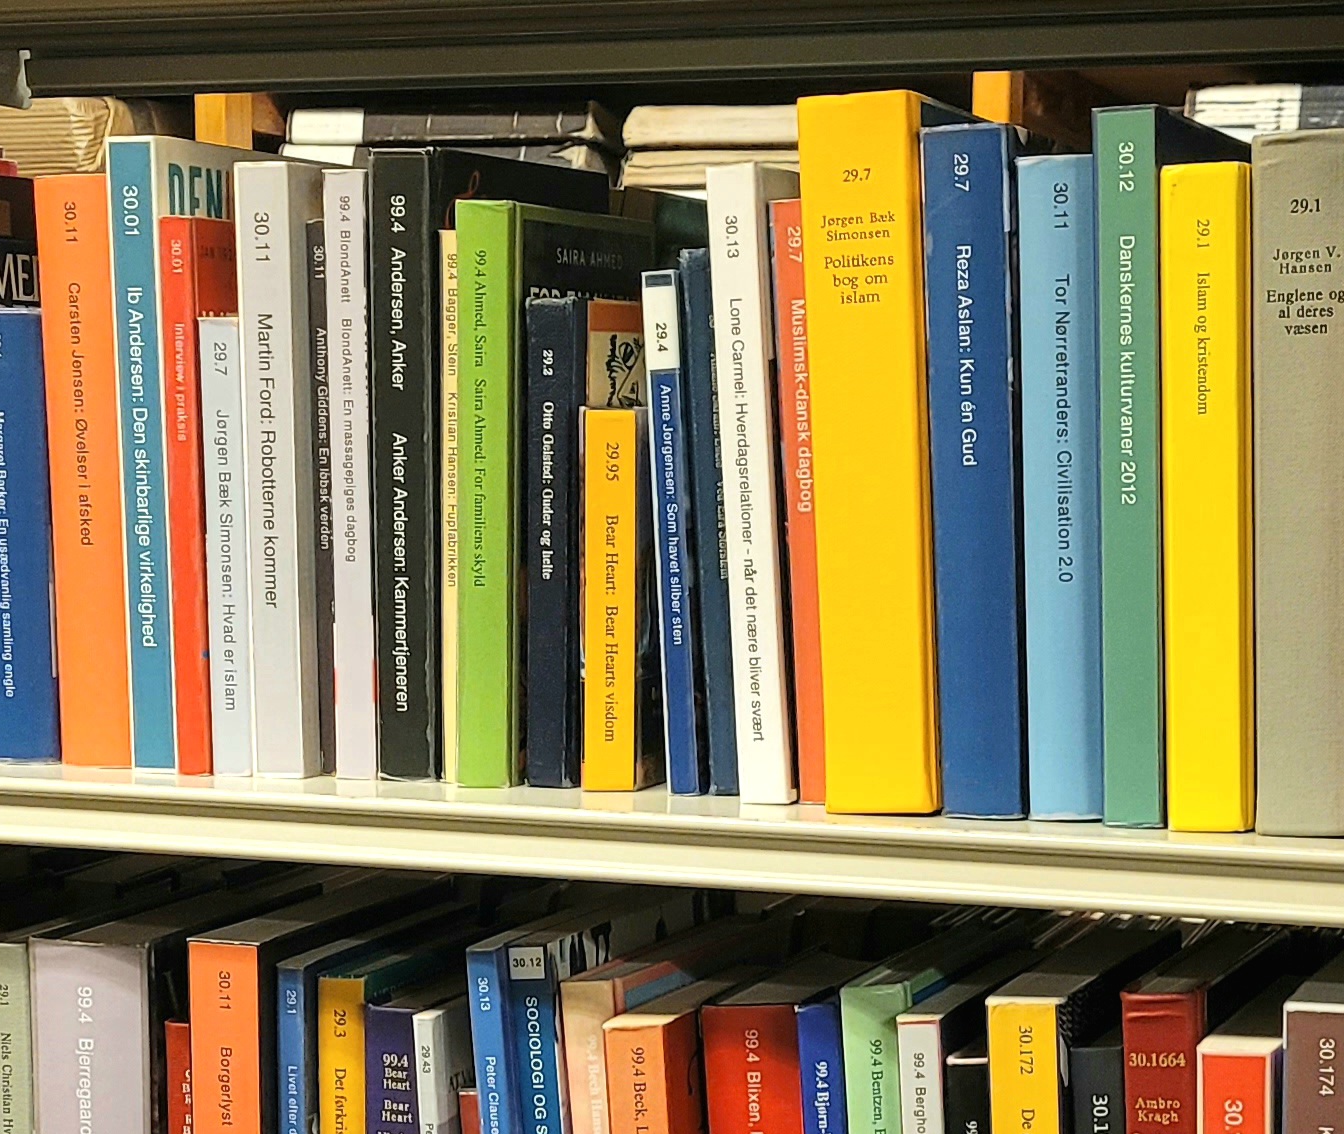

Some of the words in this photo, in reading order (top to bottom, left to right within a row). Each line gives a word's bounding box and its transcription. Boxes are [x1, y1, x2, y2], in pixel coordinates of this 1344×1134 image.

[842, 167, 871, 183] 29.7
[122, 185, 140, 235] 30.01
[389, 194, 406, 233] 99.4
[820, 215, 864, 229] Jørgen
[869, 211, 896, 223] Bæk
[1290, 198, 1321, 214] 29.1
[826, 229, 891, 242] Simonsen
[824, 254, 895, 269] Politikens
[1272, 248, 1320, 263] Jørgen
[1325, 245, 1341, 259] V.
[1279, 263, 1332, 275] Hansen
[126, 286, 143, 304] Ib
[389, 246, 407, 335] Andersen,
[832, 274, 859, 289] bog
[864, 274, 888, 285] om
[840, 290, 881, 304] islam
[1266, 288, 1324, 305] Englene
[1278, 306, 1290, 319] al
[1296, 305, 1334, 318] deres
[1284, 323, 1328, 336] væsen
[127, 308, 145, 402] Andersen:
[391, 339, 407, 391] Anker
[132, 405, 149, 444] Den
[392, 432, 408, 484] Anker
[133, 448, 153, 546] skinbarlige
[392, 486, 409, 572] Andersen:
[137, 550, 158, 647] virkelighed
[391, 576, 411, 712] Kammertjeneren
[512, 956, 542, 968] 30.12
[217, 970, 232, 1010] 30.11
[525, 996, 545, 1089] SOCIOLOGI
[1018, 1025, 1034, 1075] 30.172
[1318, 1037, 1336, 1096] 30.174
[217, 1046, 234, 1126] Borgerlyst
[533, 1093, 547, 1120] OG
[1020, 1108, 1036, 1130] De
